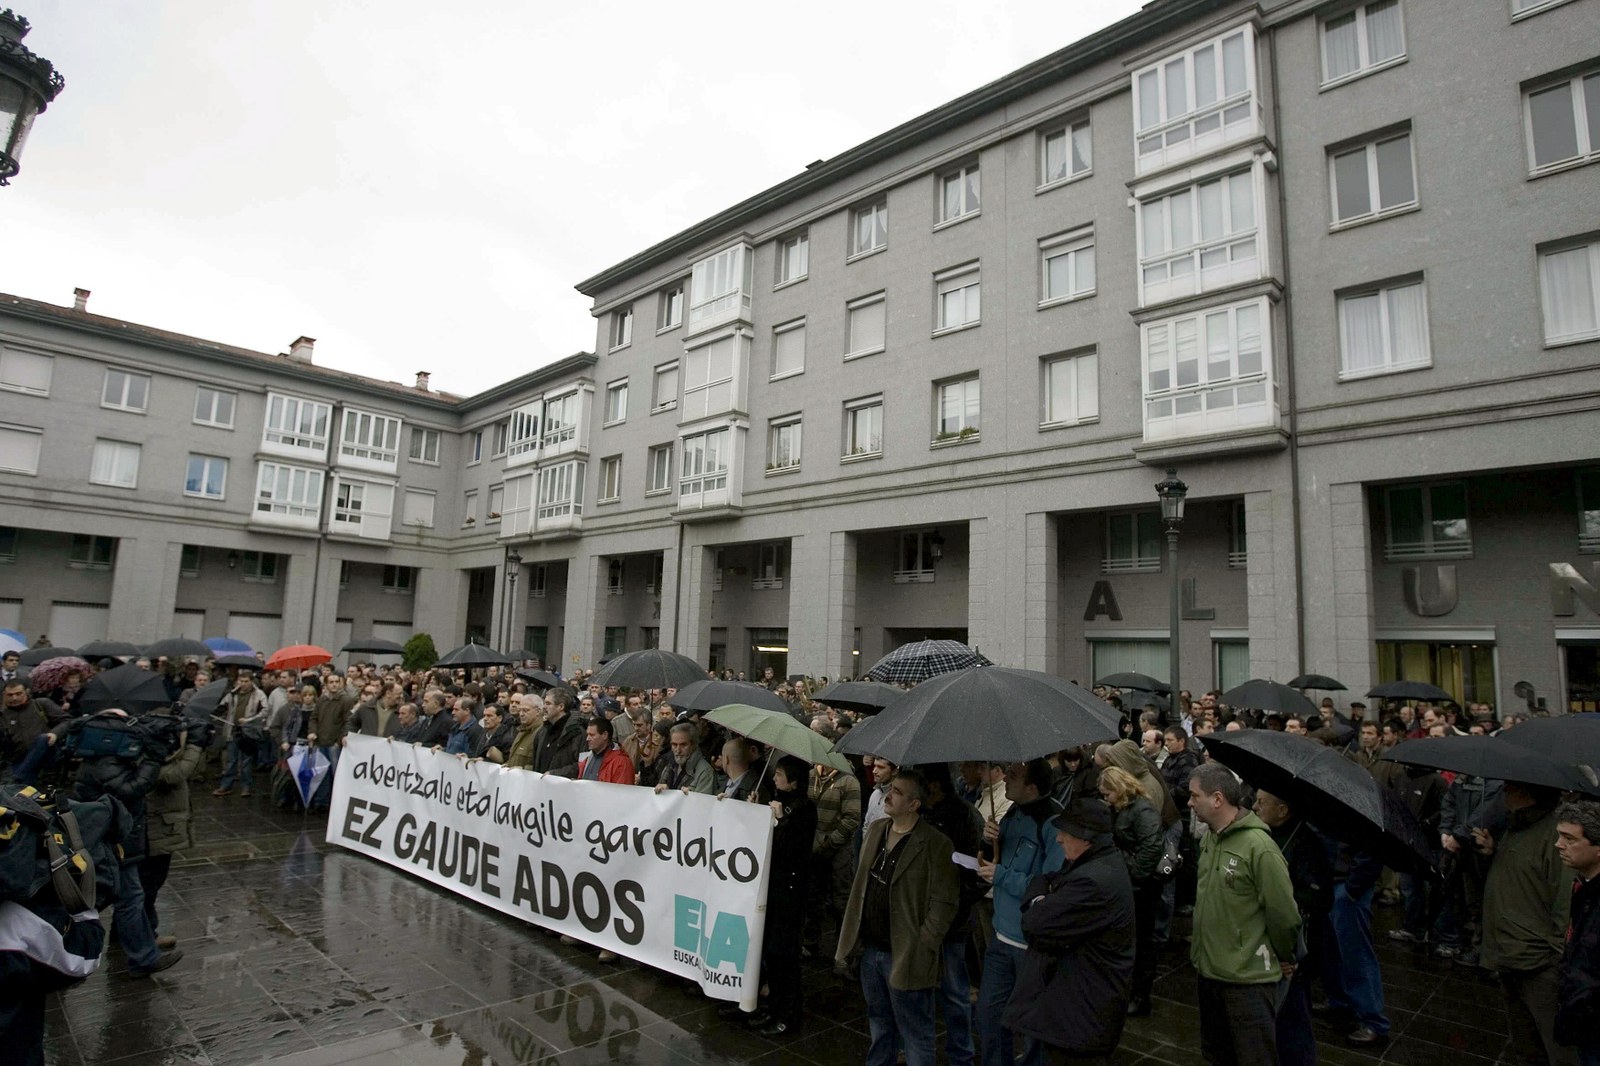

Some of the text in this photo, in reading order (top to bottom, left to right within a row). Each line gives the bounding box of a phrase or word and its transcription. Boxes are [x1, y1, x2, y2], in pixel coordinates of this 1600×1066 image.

[341, 796, 646, 946] EZ GAUDE ADOS
[352, 753, 452, 806] abertzale
[585, 818, 760, 883] garelako
[674, 893, 750, 975] ELA
